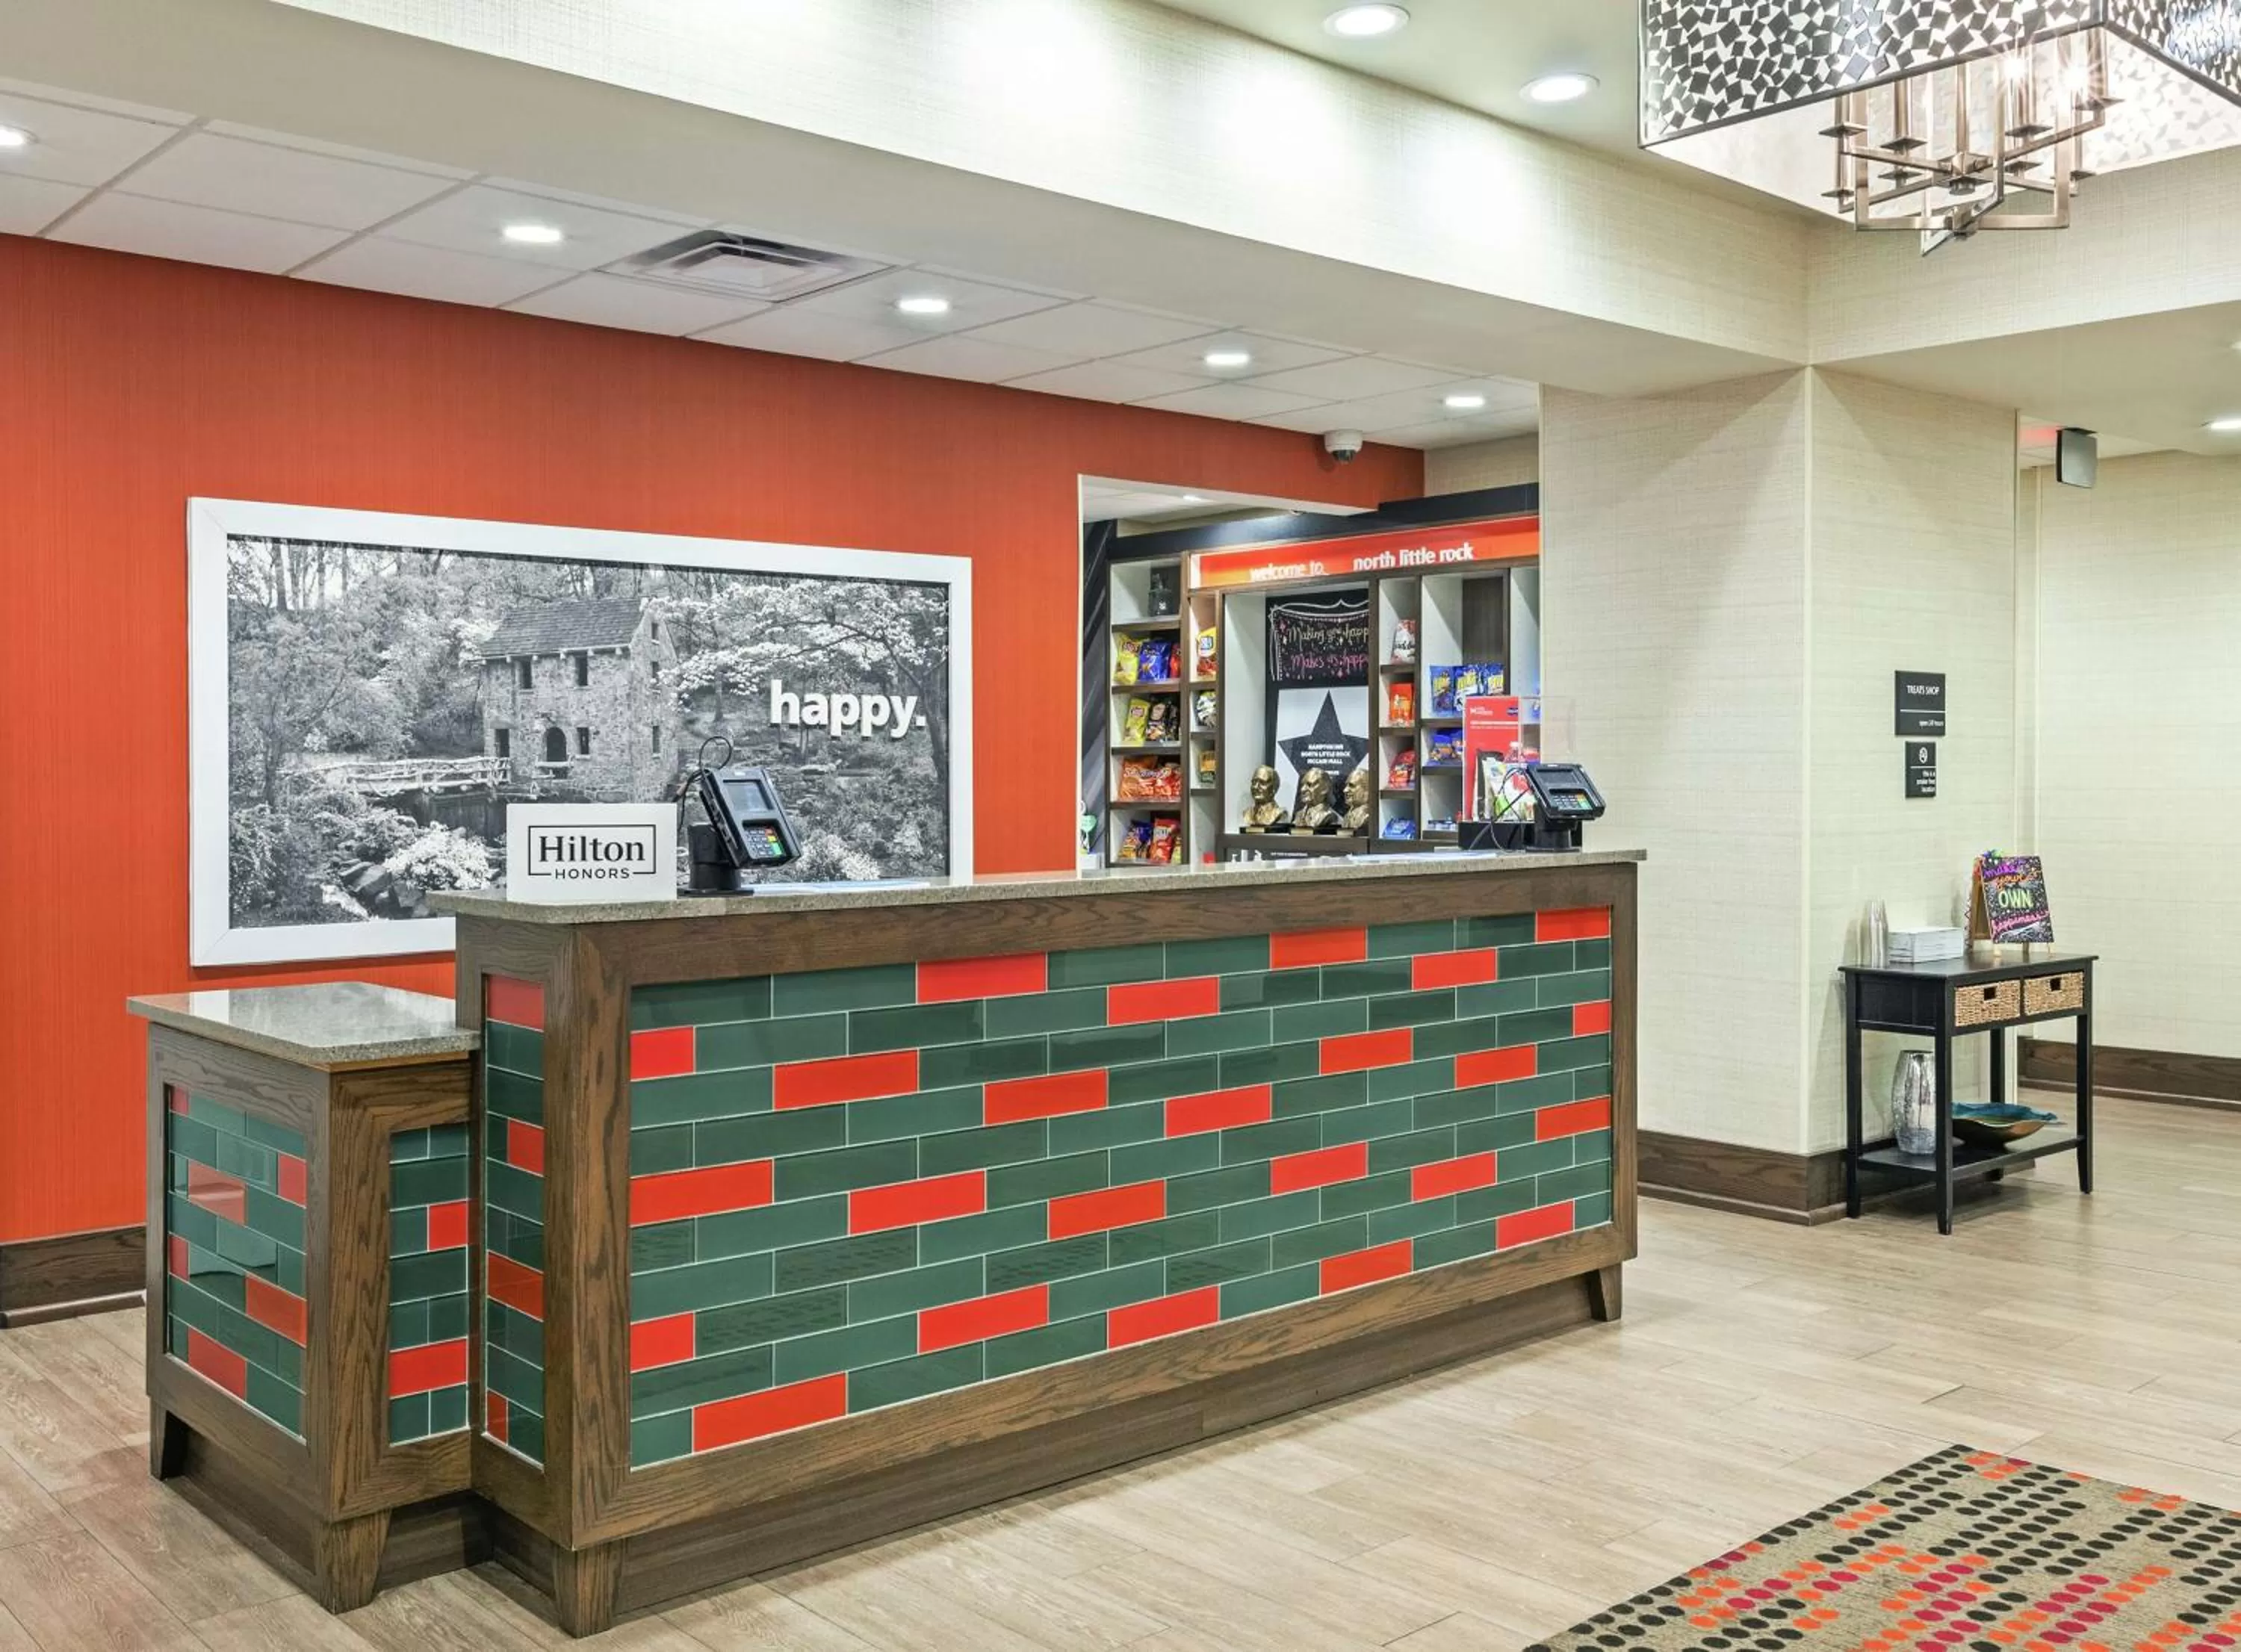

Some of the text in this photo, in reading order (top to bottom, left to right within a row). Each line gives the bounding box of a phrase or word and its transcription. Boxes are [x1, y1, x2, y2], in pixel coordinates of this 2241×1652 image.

[1249, 562, 1307, 582] welcome
[1353, 550, 1396, 572] north
[1399, 546, 1436, 568] little
[1439, 541, 1474, 562] rock
[1906, 685, 1940, 696] TREATS SHOP
[769, 678, 926, 739] happy.
[539, 835, 645, 863] Hilton
[554, 867, 630, 880] HONORS
[1998, 889, 2033, 909] OWN
